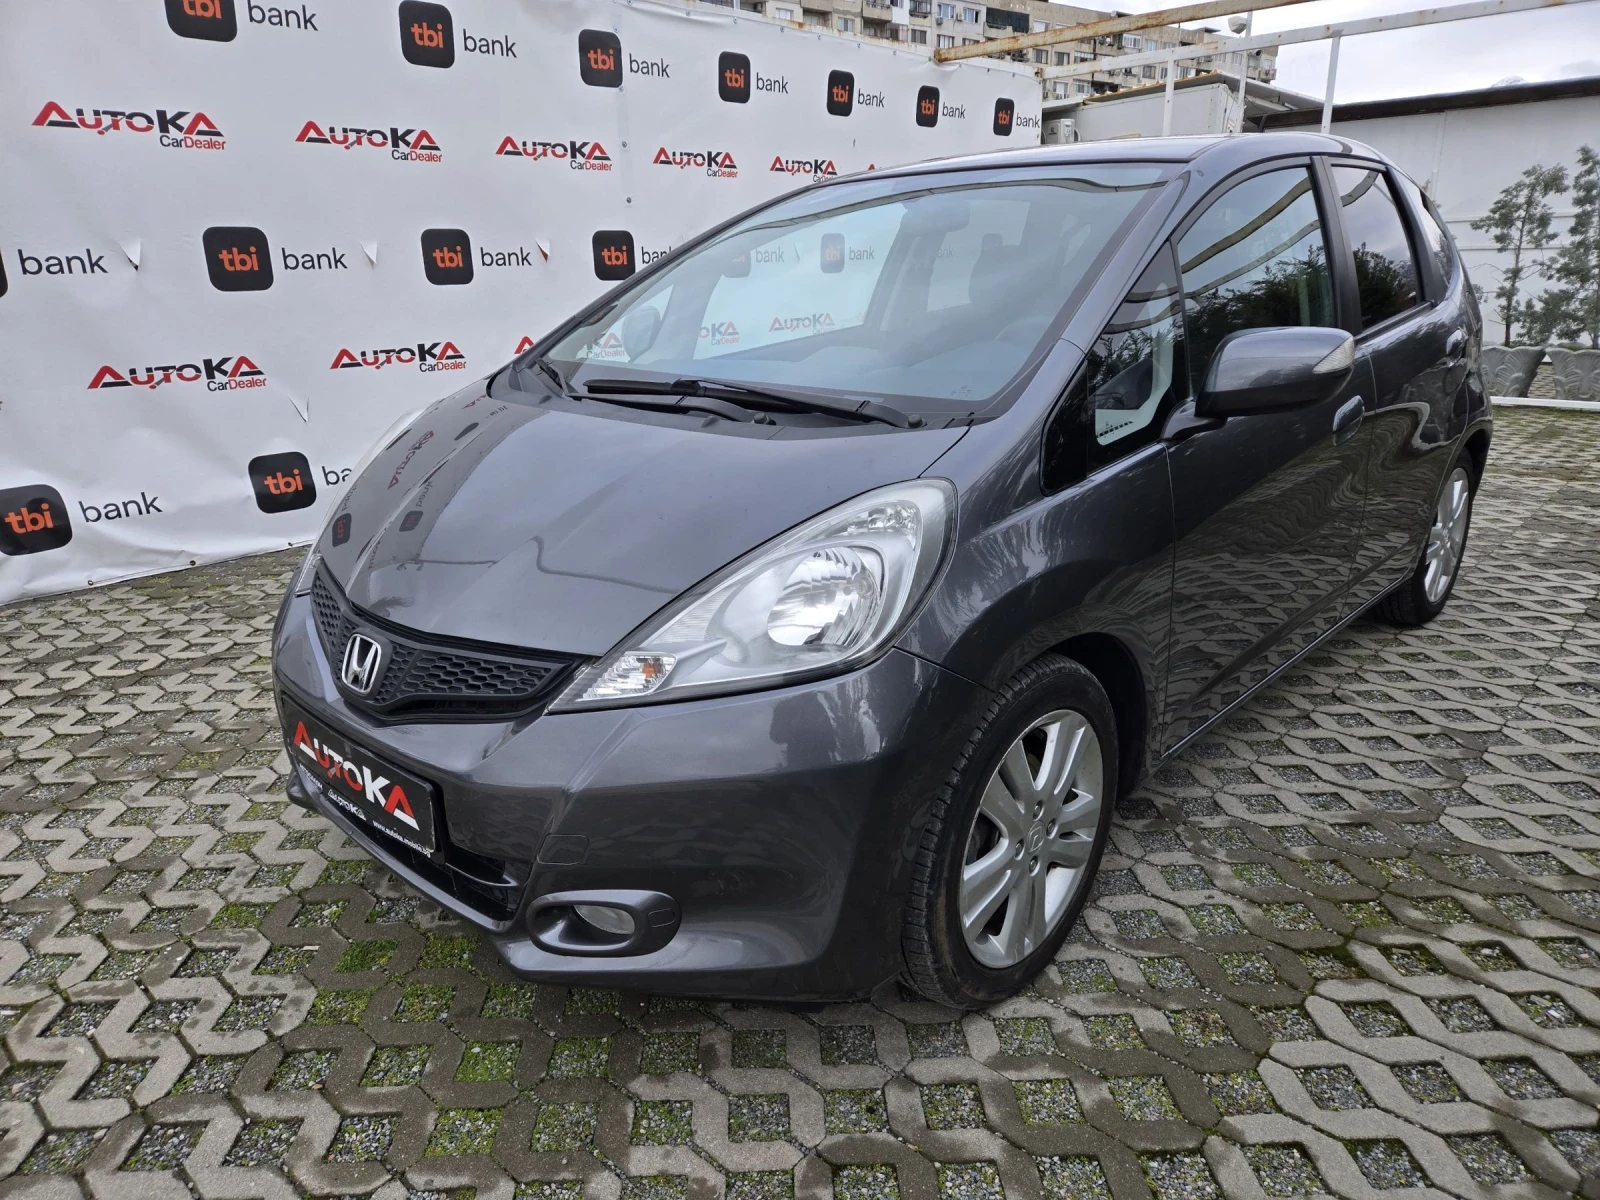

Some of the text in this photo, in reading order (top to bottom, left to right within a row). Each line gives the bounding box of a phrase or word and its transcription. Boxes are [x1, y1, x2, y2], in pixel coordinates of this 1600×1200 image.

[247, 0, 319, 31] bank
[410, 22, 518, 59] tbi bank
[587, 49, 671, 79] tbi bank
[724, 68, 789, 95] tbi bank
[832, 85, 886, 109] tbi bank
[32, 100, 225, 137] AUTOKA
[921, 98, 967, 120] tbi bank
[997, 110, 1041, 130] tbi bank
[159, 134, 227, 151] CarDealer
[295, 120, 442, 152] AUTOKA
[391, 148, 443, 163] CarDealer
[495, 136, 612, 162] AUTOKA
[653, 147, 738, 170] AUTOKA
[570, 160, 613, 172] CarDealer
[706, 167, 738, 179] CarDealer
[769, 155, 838, 177] AUTOKA
[17, 248, 109, 276] bank
[218, 246, 348, 272] tbi bank
[432, 245, 533, 268] tbi bank
[601, 245, 628, 266] tbi
[755, 246, 785, 263] bank
[849, 245, 875, 261] bank
[769, 312, 836, 333] AUTOKA
[329, 341, 466, 370] AUTOKA
[419, 360, 467, 373] CarDealer
[87, 355, 265, 390] AUTOKA
[206, 376, 267, 392] CarDealer
[263, 465, 352, 495] tbi ba
[4, 491, 163, 535] tbi bank
[293, 721, 421, 832] AUTOKA
